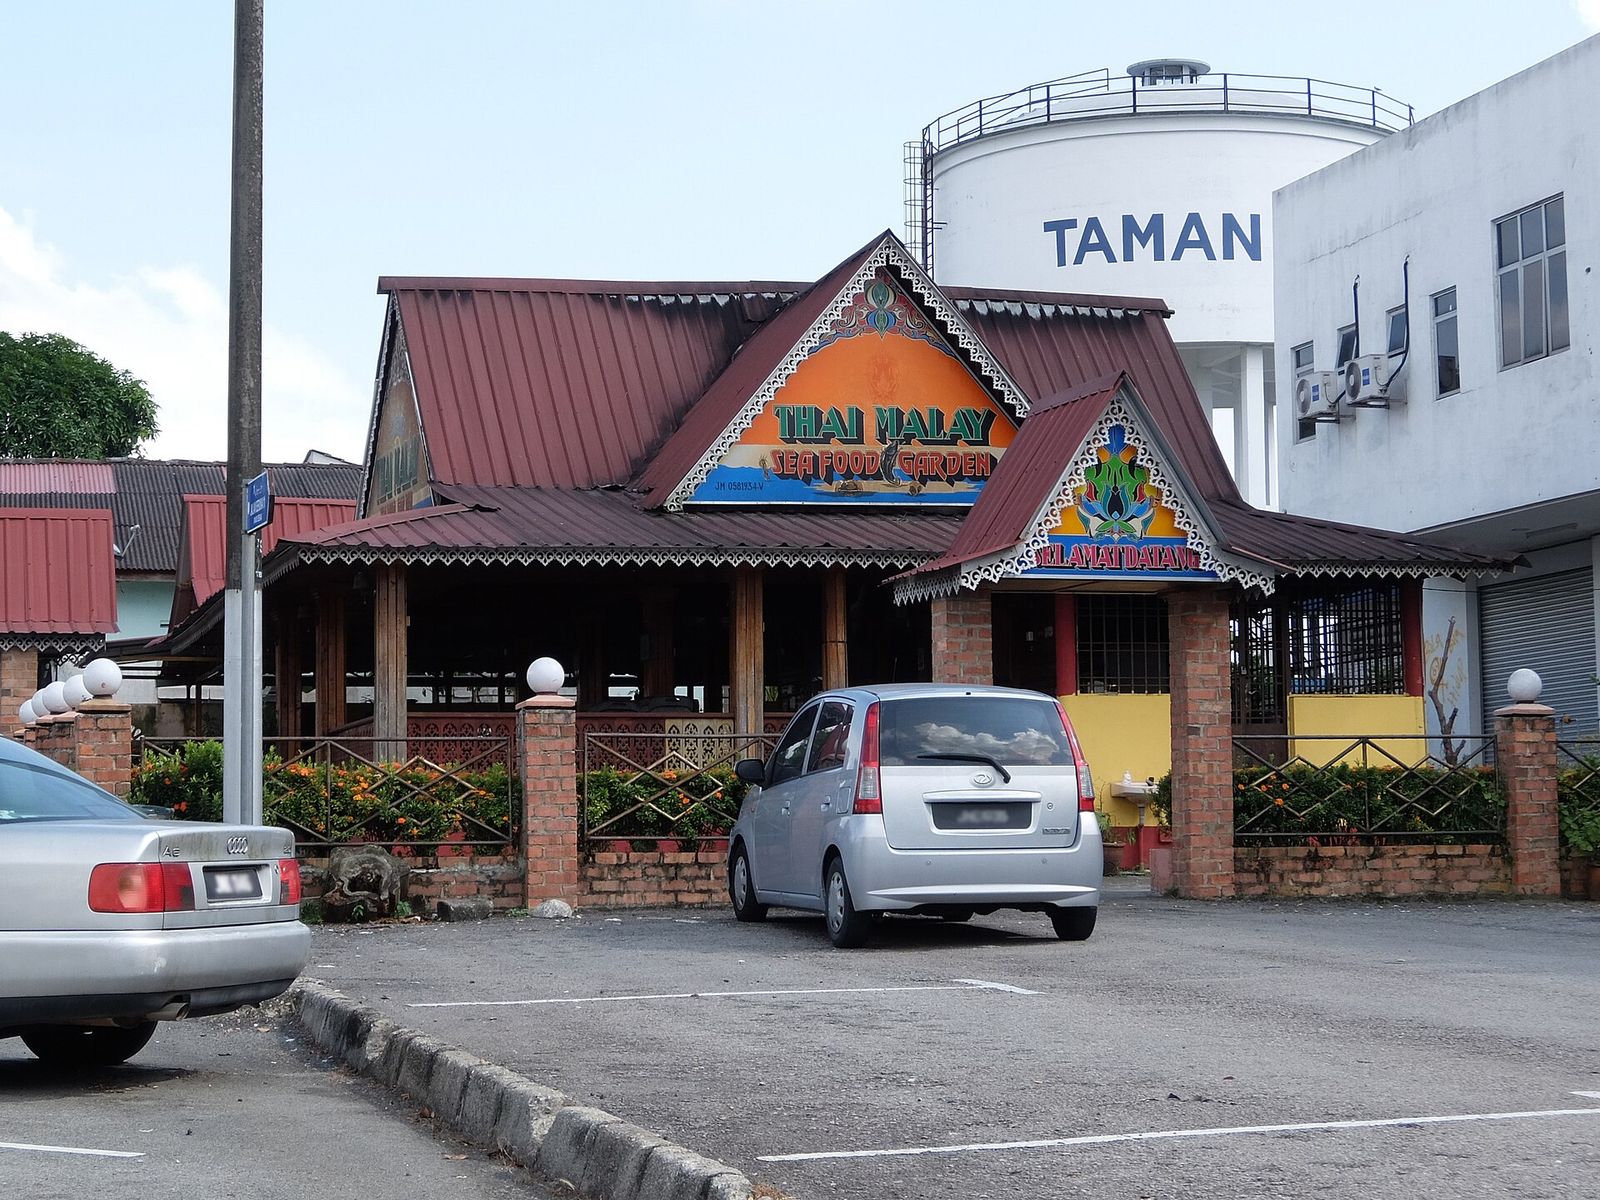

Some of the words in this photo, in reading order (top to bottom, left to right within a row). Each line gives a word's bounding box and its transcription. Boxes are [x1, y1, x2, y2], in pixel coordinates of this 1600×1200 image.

[1043, 212, 1262, 268] TAMAN
[773, 404, 864, 444] THAI
[874, 405, 997, 446] MALAY
[898, 450, 996, 484] GARDEN
[715, 481, 726, 491] JM
[1124, 544, 1201, 570] DATANG
